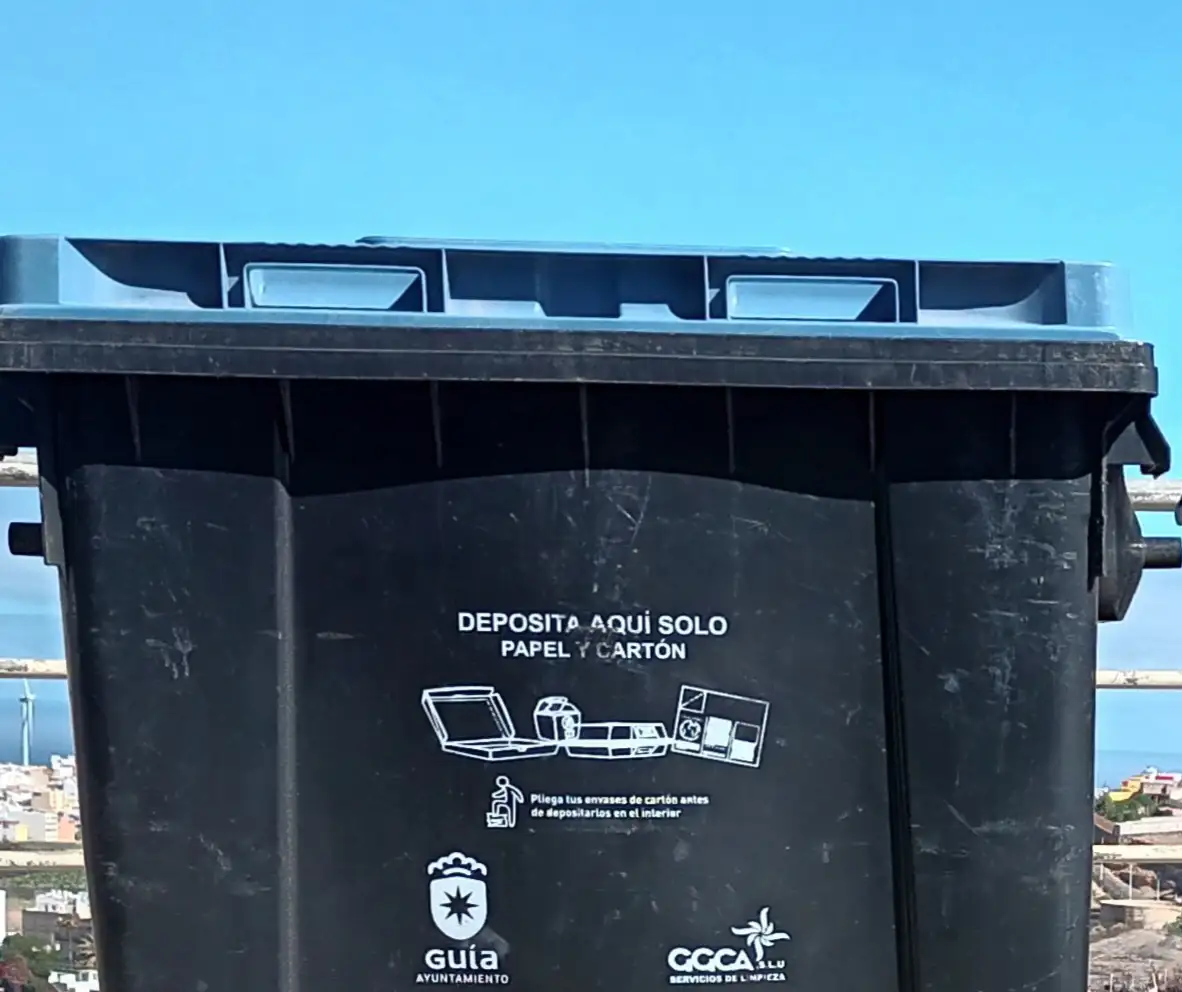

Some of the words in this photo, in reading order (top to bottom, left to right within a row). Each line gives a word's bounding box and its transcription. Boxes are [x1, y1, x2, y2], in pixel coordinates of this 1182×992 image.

[458, 612, 579, 633] DEPOSITA
[590, 610, 650, 635] AQUÍ
[658, 615, 728, 636] SOLO
[501, 640, 570, 658] PAPEL
[575, 641, 590, 659] Y
[596, 638, 686, 659] CARTÓN
[530, 793, 563, 806] Pliega
[565, 795, 583, 804] tus
[585, 796, 627, 804] envases
[629, 795, 643, 804] de
[644, 794, 678, 805] cartón
[531, 808, 544, 817] de
[546, 808, 611, 819] depositarlos
[613, 809, 627, 818] en
[629, 808, 640, 818] el
[415, 973, 509, 984] AYUNTAMIENTO
[669, 974, 723, 984] SERVICIOS
[724, 974, 738, 983] DE
